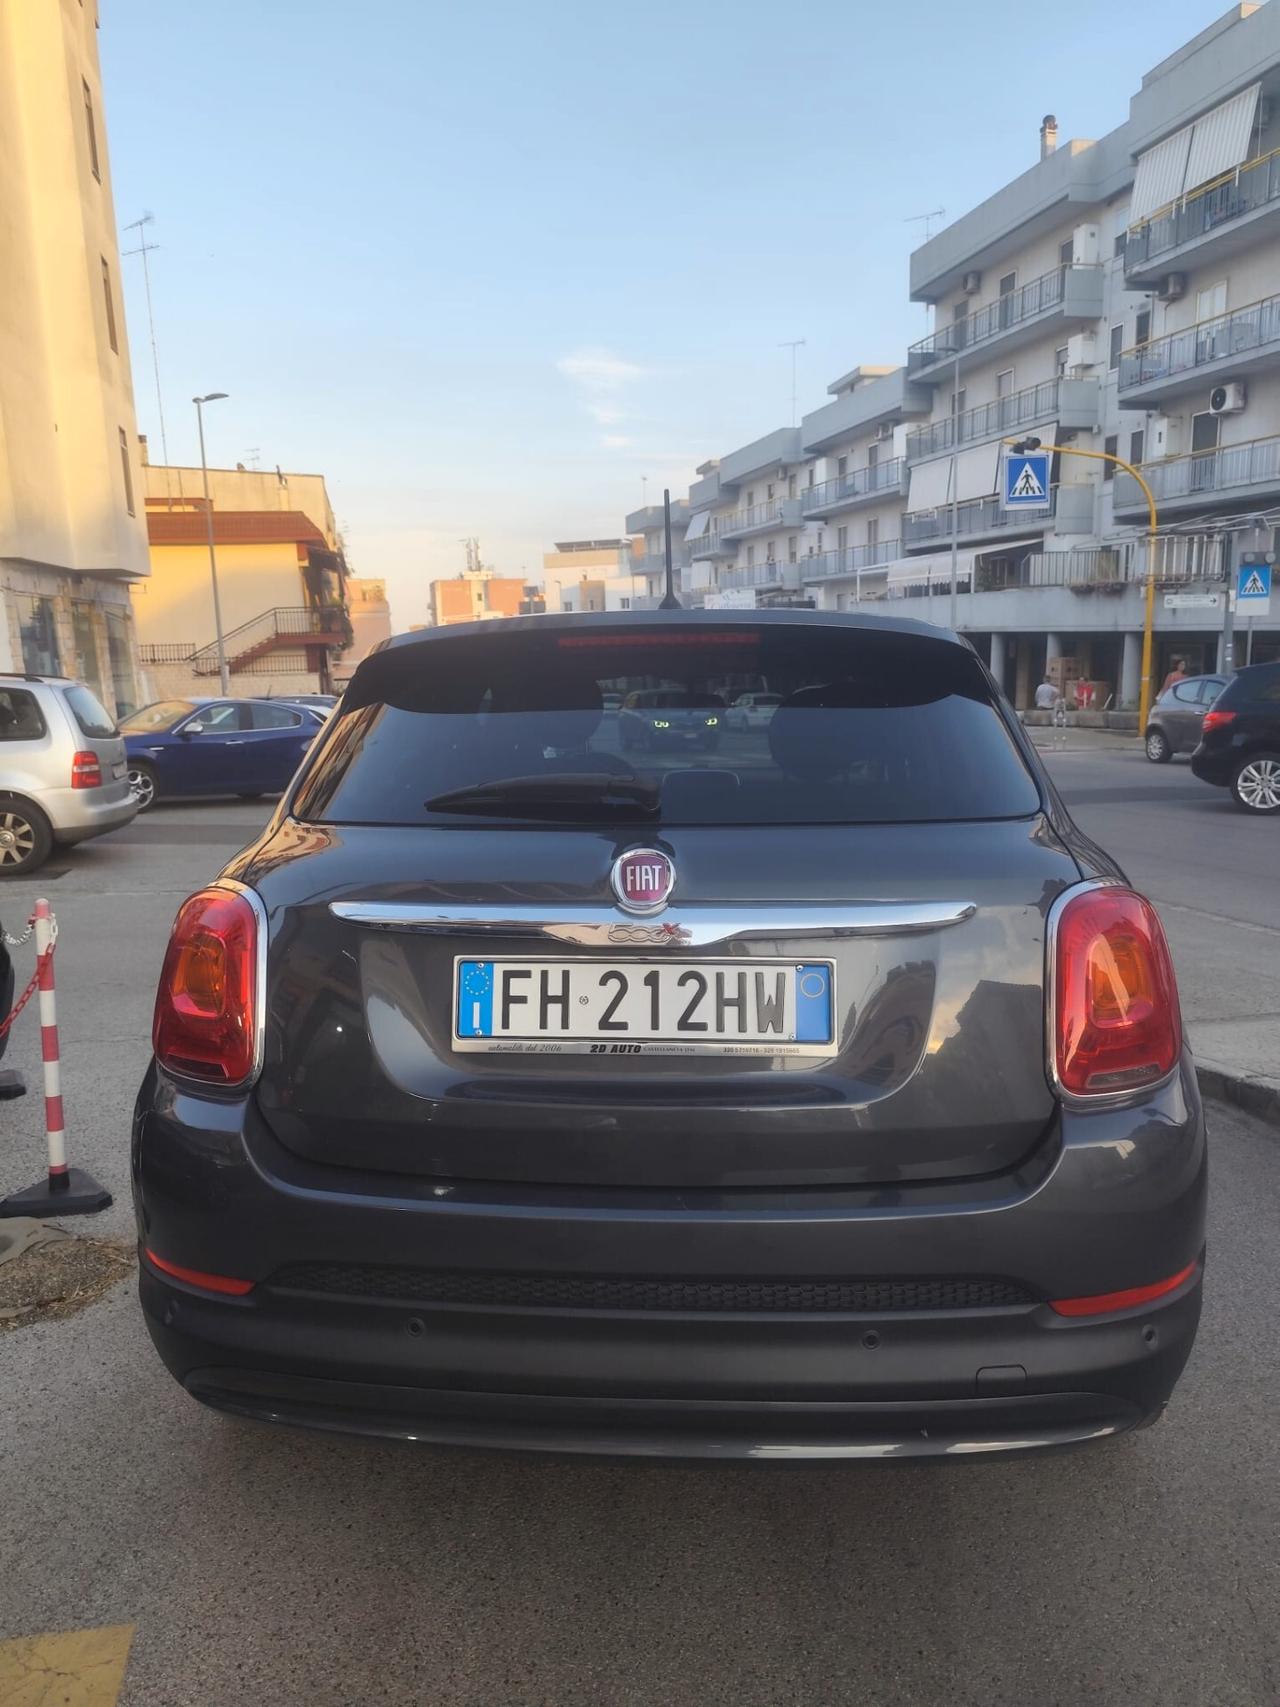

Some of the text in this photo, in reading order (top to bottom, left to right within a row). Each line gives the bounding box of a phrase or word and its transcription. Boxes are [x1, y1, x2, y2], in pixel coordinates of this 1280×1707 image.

[625, 865, 662, 892] FIAT
[501, 969, 786, 1033] FH 212HW
[610, 1044, 642, 1053] AUTO
